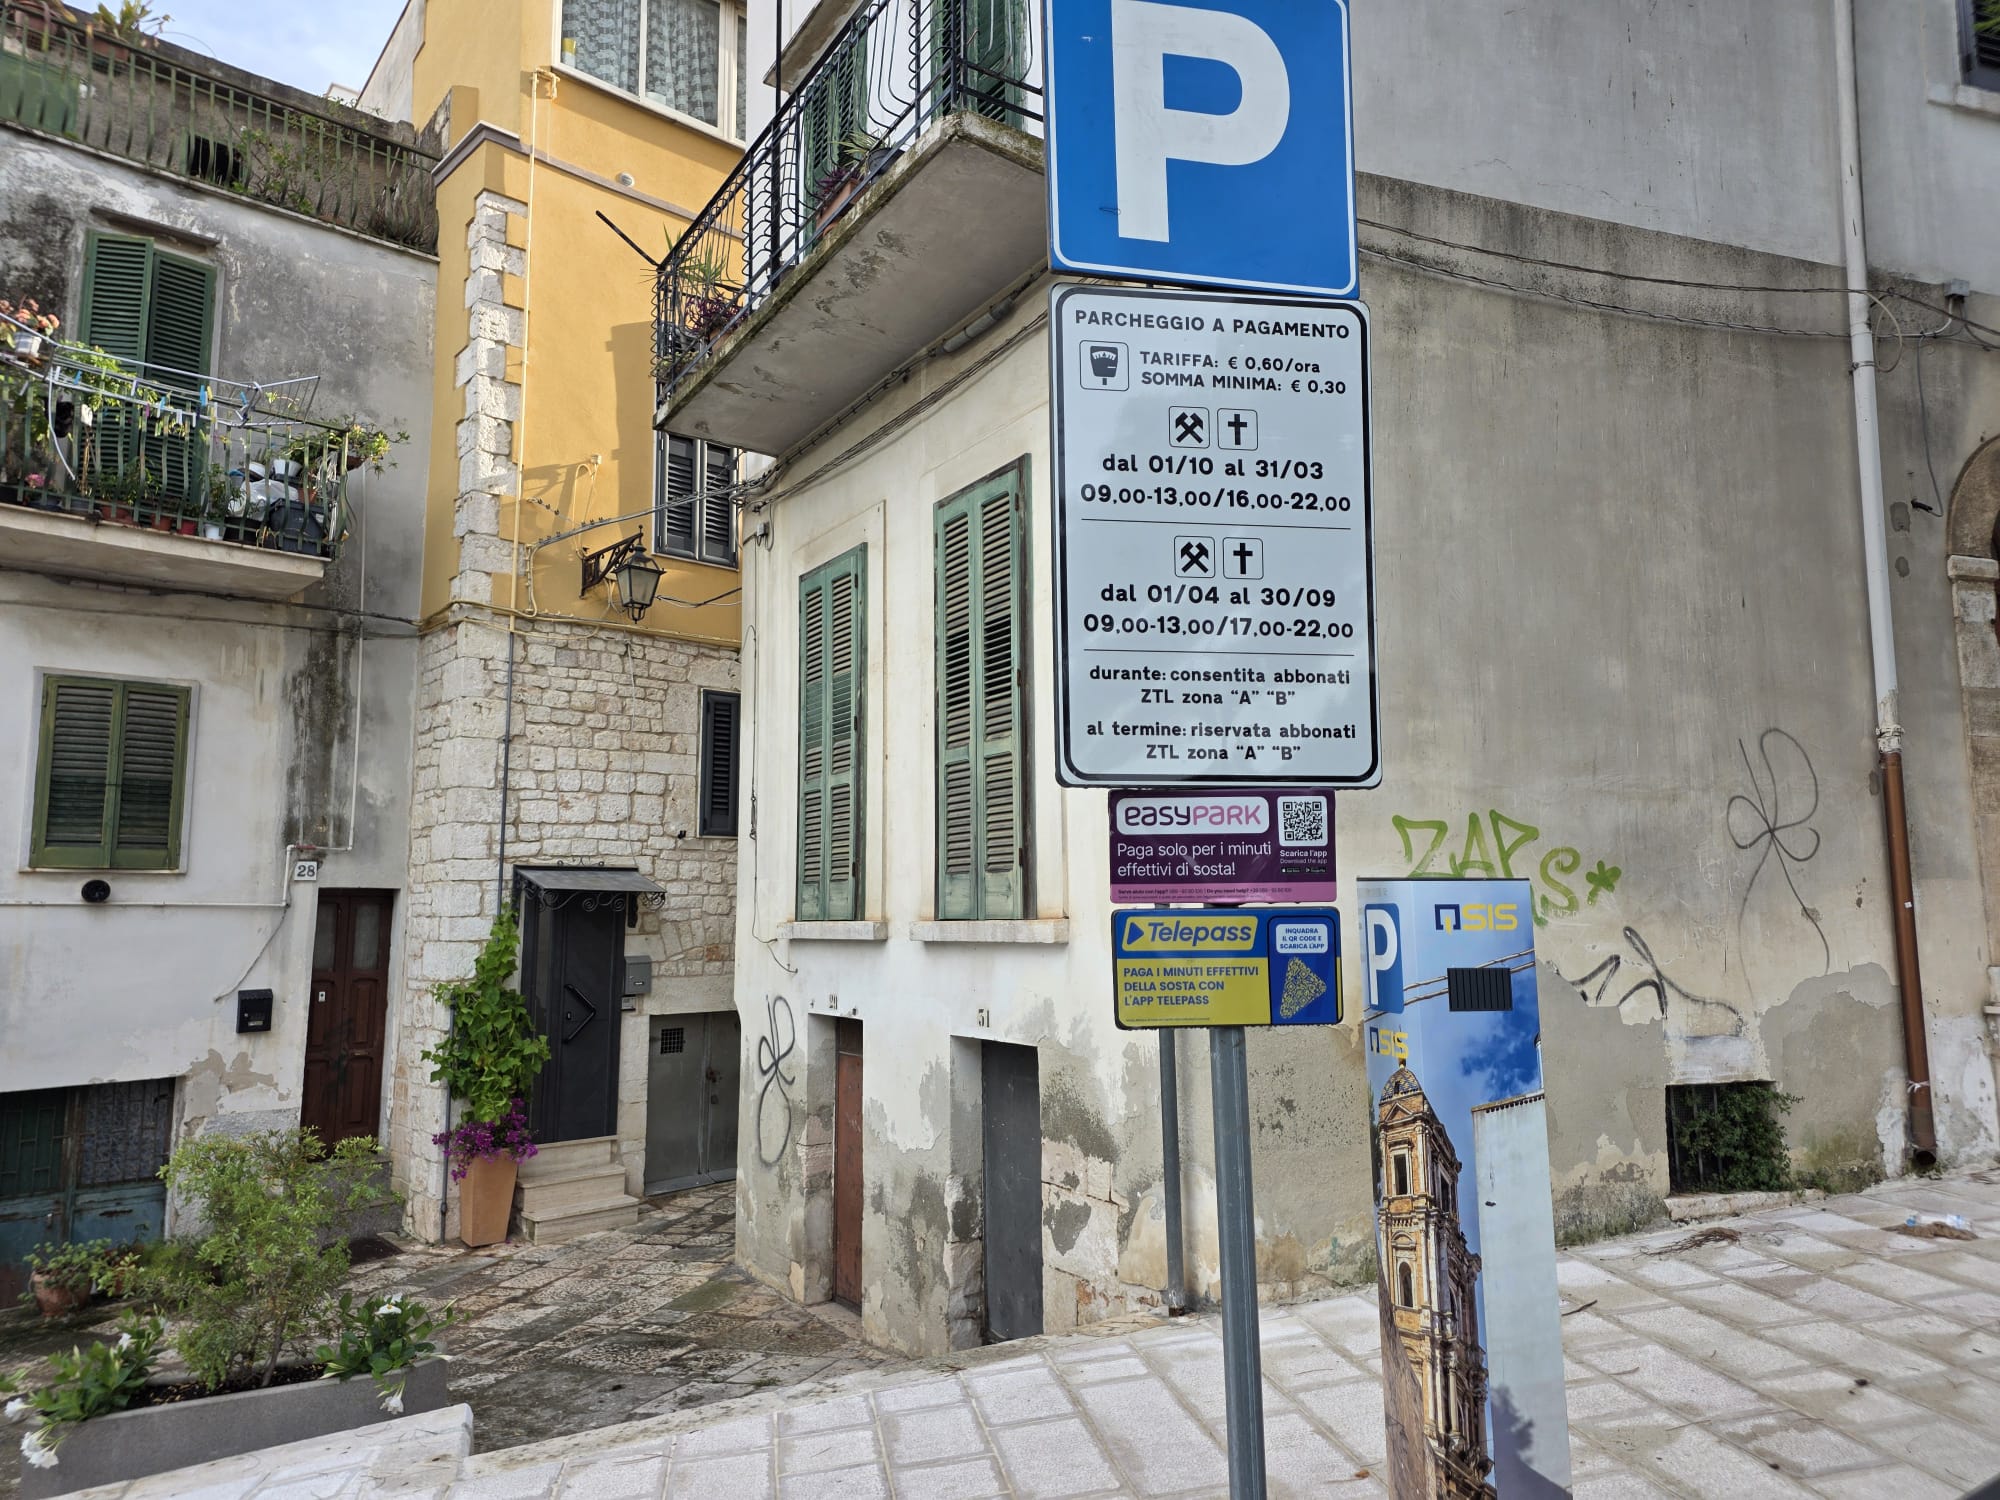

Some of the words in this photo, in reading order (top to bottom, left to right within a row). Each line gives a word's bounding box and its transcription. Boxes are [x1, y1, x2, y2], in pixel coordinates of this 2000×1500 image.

[1111, 0, 1290, 243] P
[1075, 310, 1204, 331] PARCHEGGIO
[1212, 318, 1225, 333] A
[1233, 319, 1350, 339] PAGAMENTO
[1140, 351, 1219, 368] TARIFFA:
[1228, 356, 1238, 369] €
[1245, 356, 1320, 373] 0,60/ora
[1141, 372, 1204, 387] SOMMA
[1212, 375, 1282, 391] MINIMA:
[1291, 380, 1300, 393] €
[1307, 379, 1346, 395] 0,30
[1102, 454, 1138, 472] dal
[1149, 456, 1214, 476] 01/10
[1225, 459, 1244, 476] al
[1255, 460, 1324, 480] 31/03
[1100, 584, 1136, 602] dal
[1148, 584, 1219, 605] 01/04
[1230, 587, 1250, 605] al
[1260, 587, 1336, 608] 30/09
[1089, 665, 1166, 682] durante:
[1170, 667, 1266, 683] consentita
[1274, 668, 1350, 685] abbonati
[1141, 688, 1174, 704] ZTL
[1182, 692, 1223, 704] zona
[1087, 721, 1104, 736] al
[1112, 721, 1187, 737] termine:
[1191, 722, 1271, 738] riservata
[1279, 723, 1356, 739] abbonati
[1146, 744, 1179, 759] ZTL
[1187, 749, 1229, 760] zona
[1117, 843, 1154, 860] Paga
[1158, 842, 1187, 856] solo
[1192, 844, 1216, 859] per
[1220, 841, 1224, 855] i
[1228, 841, 1272, 855] minuti
[1280, 849, 1309, 857] Scarica
[297, 864, 316, 877] 28
[1117, 862, 1171, 877] effettivi
[1176, 862, 1189, 876] di
[1193, 861, 1236, 876] sosta!
[1147, 920, 1252, 947] Telepass
[1366, 908, 1398, 1005] P
[1123, 967, 1154, 977] PAGA
[1157, 967, 1160, 976] I
[1163, 966, 1203, 976] MINUTI
[1206, 966, 1259, 976] EFFETTIVI
[1124, 981, 1156, 991] DELLA
[1159, 981, 1196, 991] SOSTA
[1198, 980, 1225, 990] CON
[1124, 995, 1154, 1006] L'APP
[1156, 995, 1209, 1006] TELEPASS
